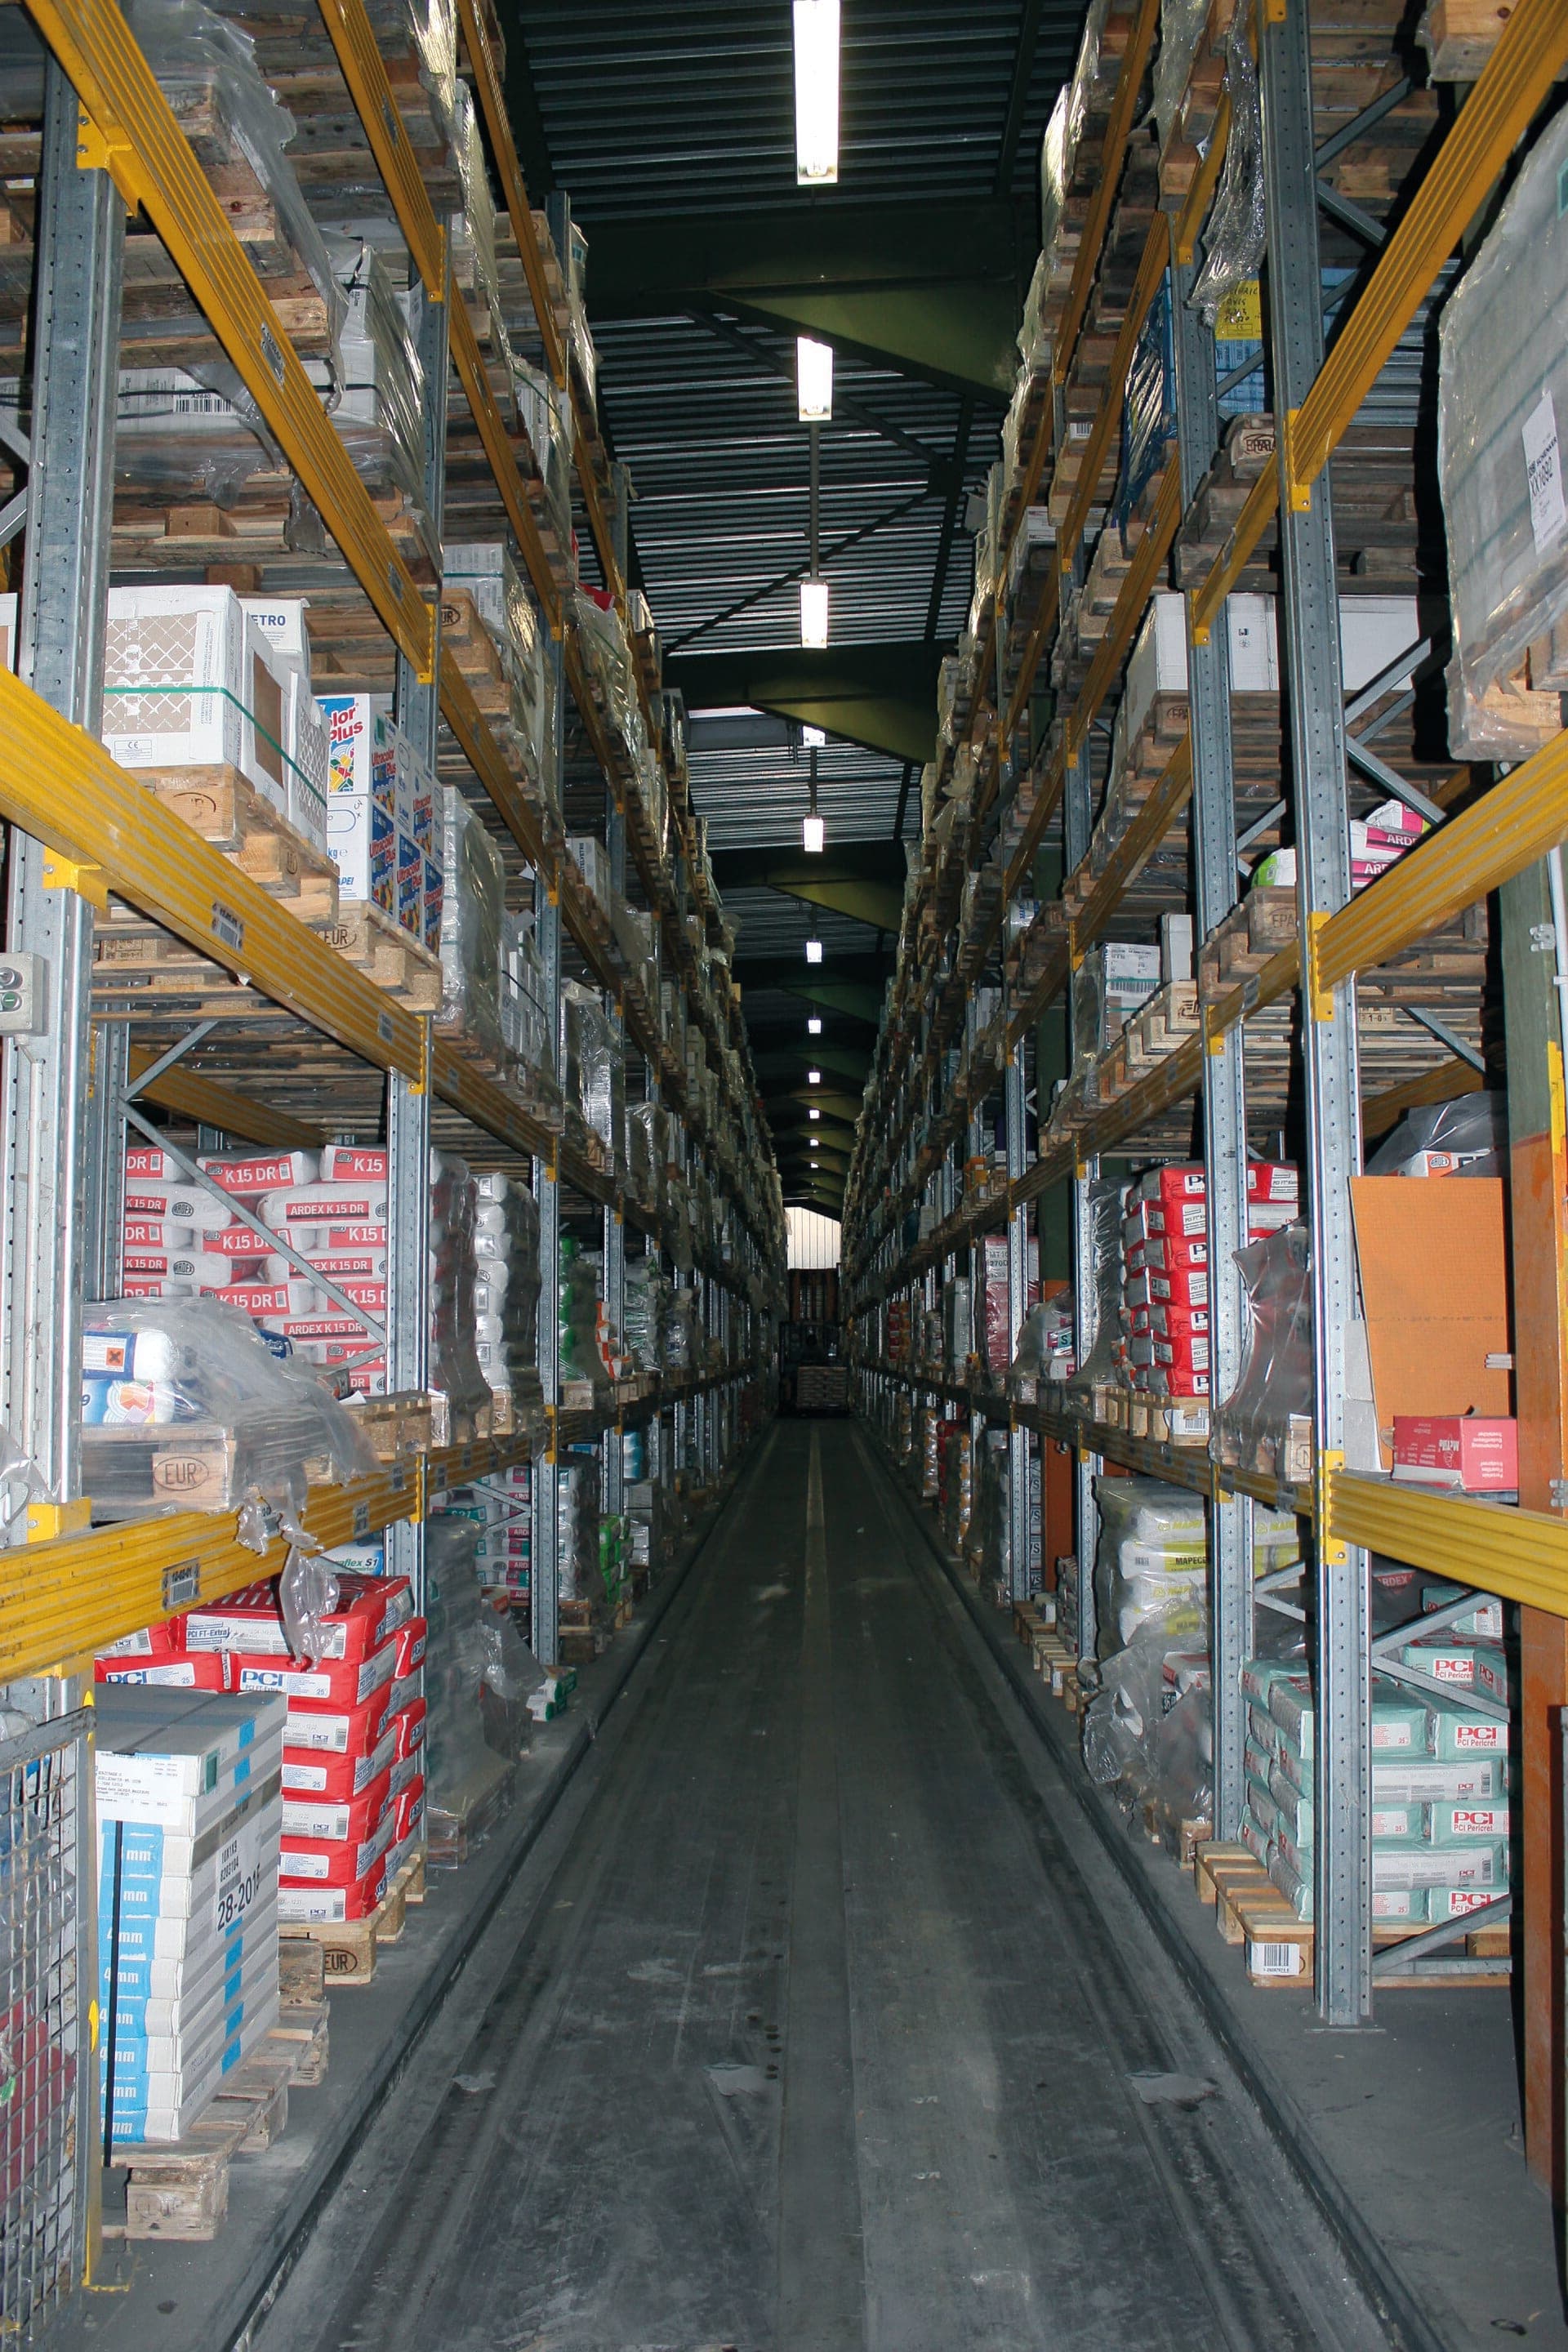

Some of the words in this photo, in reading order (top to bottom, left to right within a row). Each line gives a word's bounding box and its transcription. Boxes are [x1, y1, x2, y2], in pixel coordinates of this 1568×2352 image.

[328, 847, 338, 860] kg
[324, 929, 348, 946] EUR
[127, 1156, 146, 1169] DR
[354, 1158, 364, 1172] K
[364, 1159, 383, 1172] 15
[225, 1172, 234, 1183] K
[237, 1170, 252, 1183] 15
[256, 1166, 276, 1181] DR
[133, 1199, 145, 1208] 15
[148, 1200, 162, 1210] DR
[291, 1205, 324, 1215] ARDEX
[327, 1205, 334, 1214] K
[336, 1205, 347, 1214] 15
[350, 1204, 364, 1214] DR
[126, 1227, 145, 1240] DR
[349, 1228, 360, 1241] K
[360, 1227, 378, 1241] 15
[222, 1236, 232, 1250] K
[234, 1235, 250, 1249] 15
[127, 1259, 134, 1268] K
[135, 1258, 146, 1268] 15
[150, 1259, 163, 1268] DR
[330, 1263, 337, 1271] K
[339, 1262, 350, 1271] 15
[353, 1260, 368, 1270] DR
[232, 1295, 247, 1307] 15
[252, 1294, 272, 1307] DR
[348, 1290, 359, 1303] K
[359, 1290, 376, 1303] 15
[288, 1324, 322, 1335] ARDEX
[325, 1324, 332, 1332] K
[334, 1324, 345, 1332] 15
[348, 1323, 363, 1332] DR
[350, 1378, 364, 1388] DR
[82, 1394, 91, 1406] 9
[165, 1463, 198, 1485] EUR
[364, 1557, 379, 1567] S1
[1435, 1659, 1473, 1673] PCI
[242, 1670, 283, 1686] PCI
[316, 1687, 325, 1695] 25
[1457, 1726, 1497, 1740] PCI
[1470, 1739, 1496, 1747] Pericret
[1458, 1783, 1474, 1791] PCI
[1454, 1811, 1493, 1824] PCI
[313, 1824, 329, 1832] PCI
[1468, 1824, 1493, 1832] Pericret
[126, 1849, 151, 1862] mm
[123, 1890, 147, 1902] mm
[1451, 1892, 1491, 1906] PCI
[118, 1931, 143, 1944] mm
[325, 1953, 348, 1971] EUR
[117, 1971, 138, 1984] mm
[114, 2085, 136, 2098] mm
